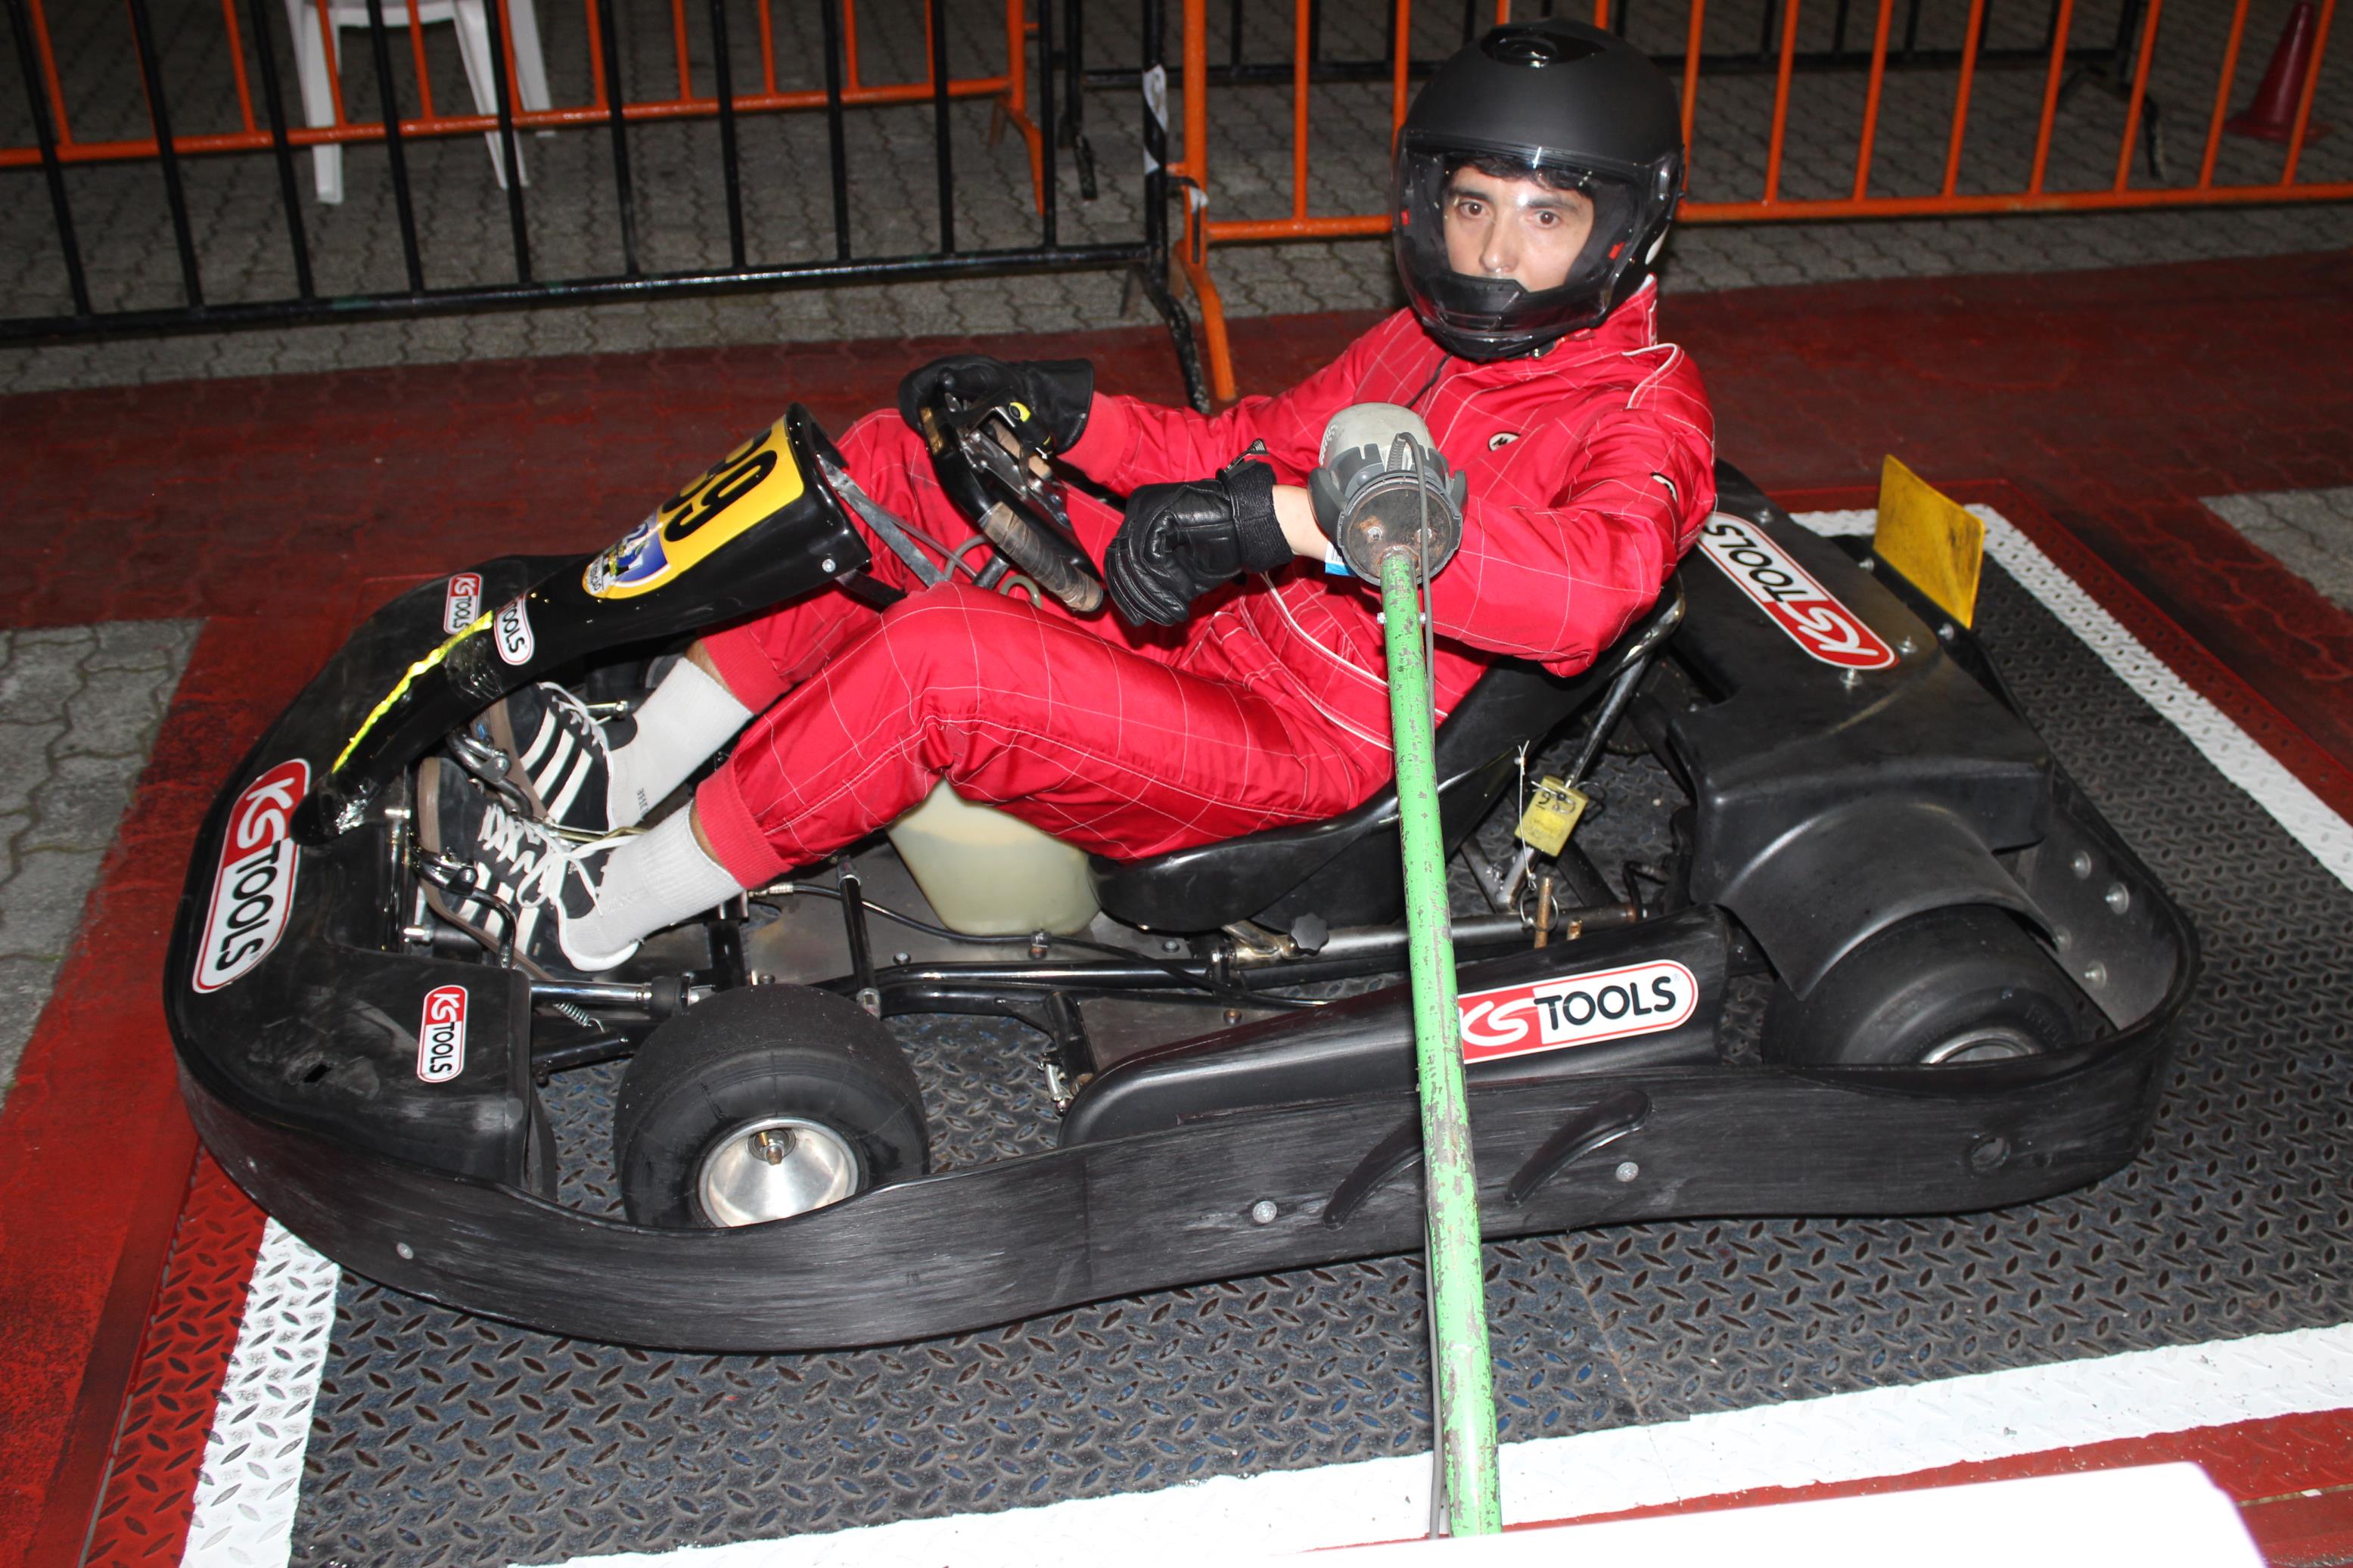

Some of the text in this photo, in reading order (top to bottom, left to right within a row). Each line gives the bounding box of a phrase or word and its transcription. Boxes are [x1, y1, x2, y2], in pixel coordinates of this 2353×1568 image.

[453, 577, 476, 629] KS TOOLS
[1704, 525, 1879, 656] KS TOOLS
[216, 778, 296, 971] KS TOOLS
[429, 993, 460, 1073] KS TOOLS
[1534, 976, 1677, 1030] TOOLS
